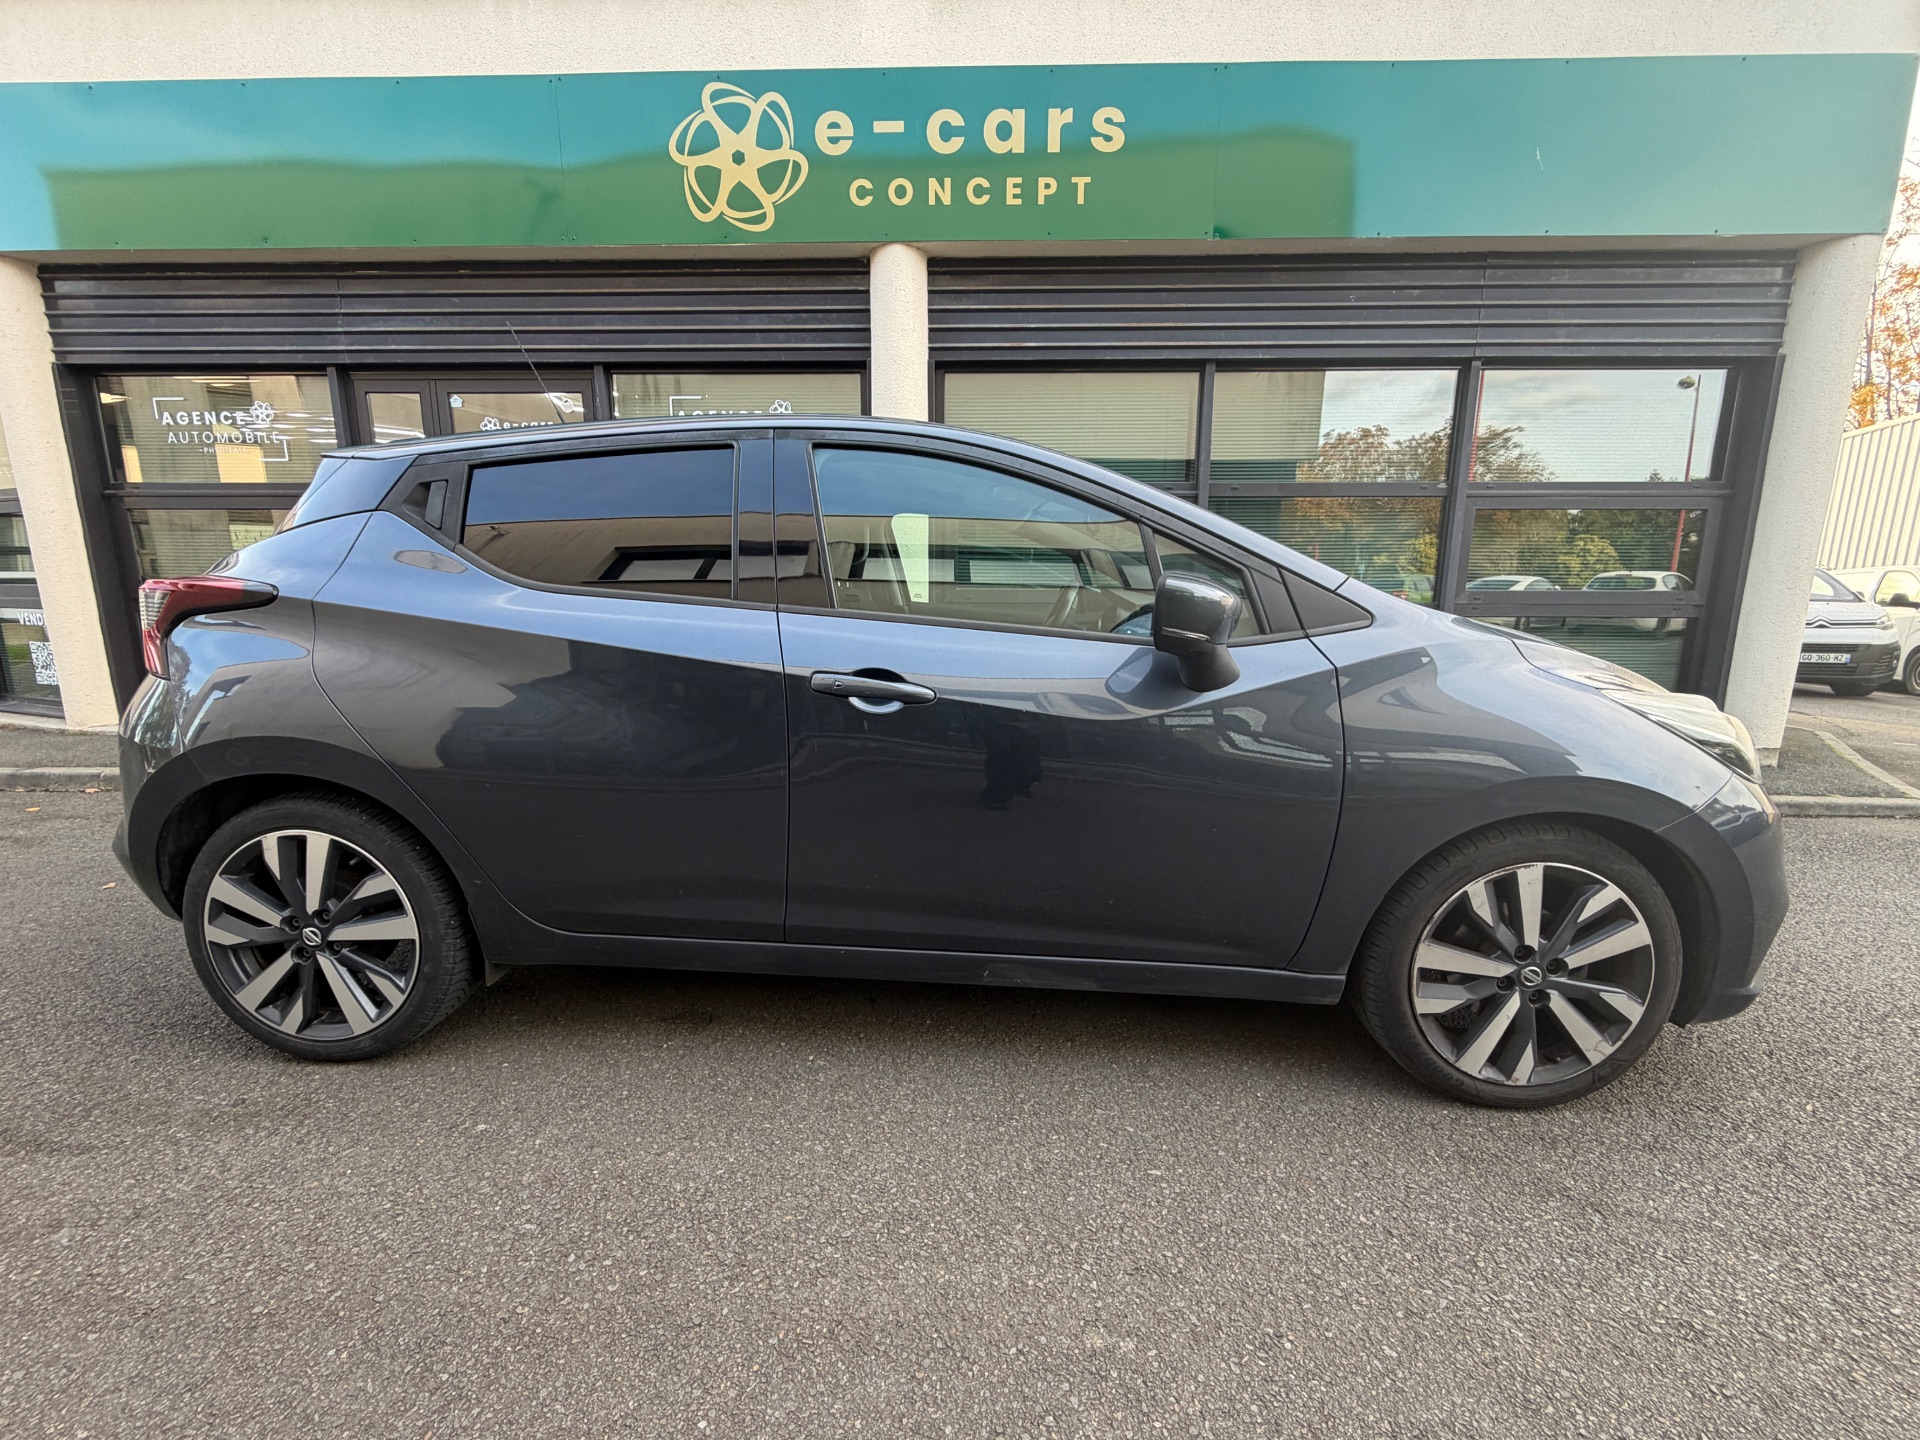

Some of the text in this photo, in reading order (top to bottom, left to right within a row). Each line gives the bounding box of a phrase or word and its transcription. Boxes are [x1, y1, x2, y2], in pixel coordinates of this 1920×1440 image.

[814, 106, 1126, 156] e-cars
[849, 176, 1092, 207] CONCEPT
[162, 411, 246, 425] AGENCE
[168, 431, 280, 443] AUTOMOBILE
[17, 612, 46, 625] VEND
